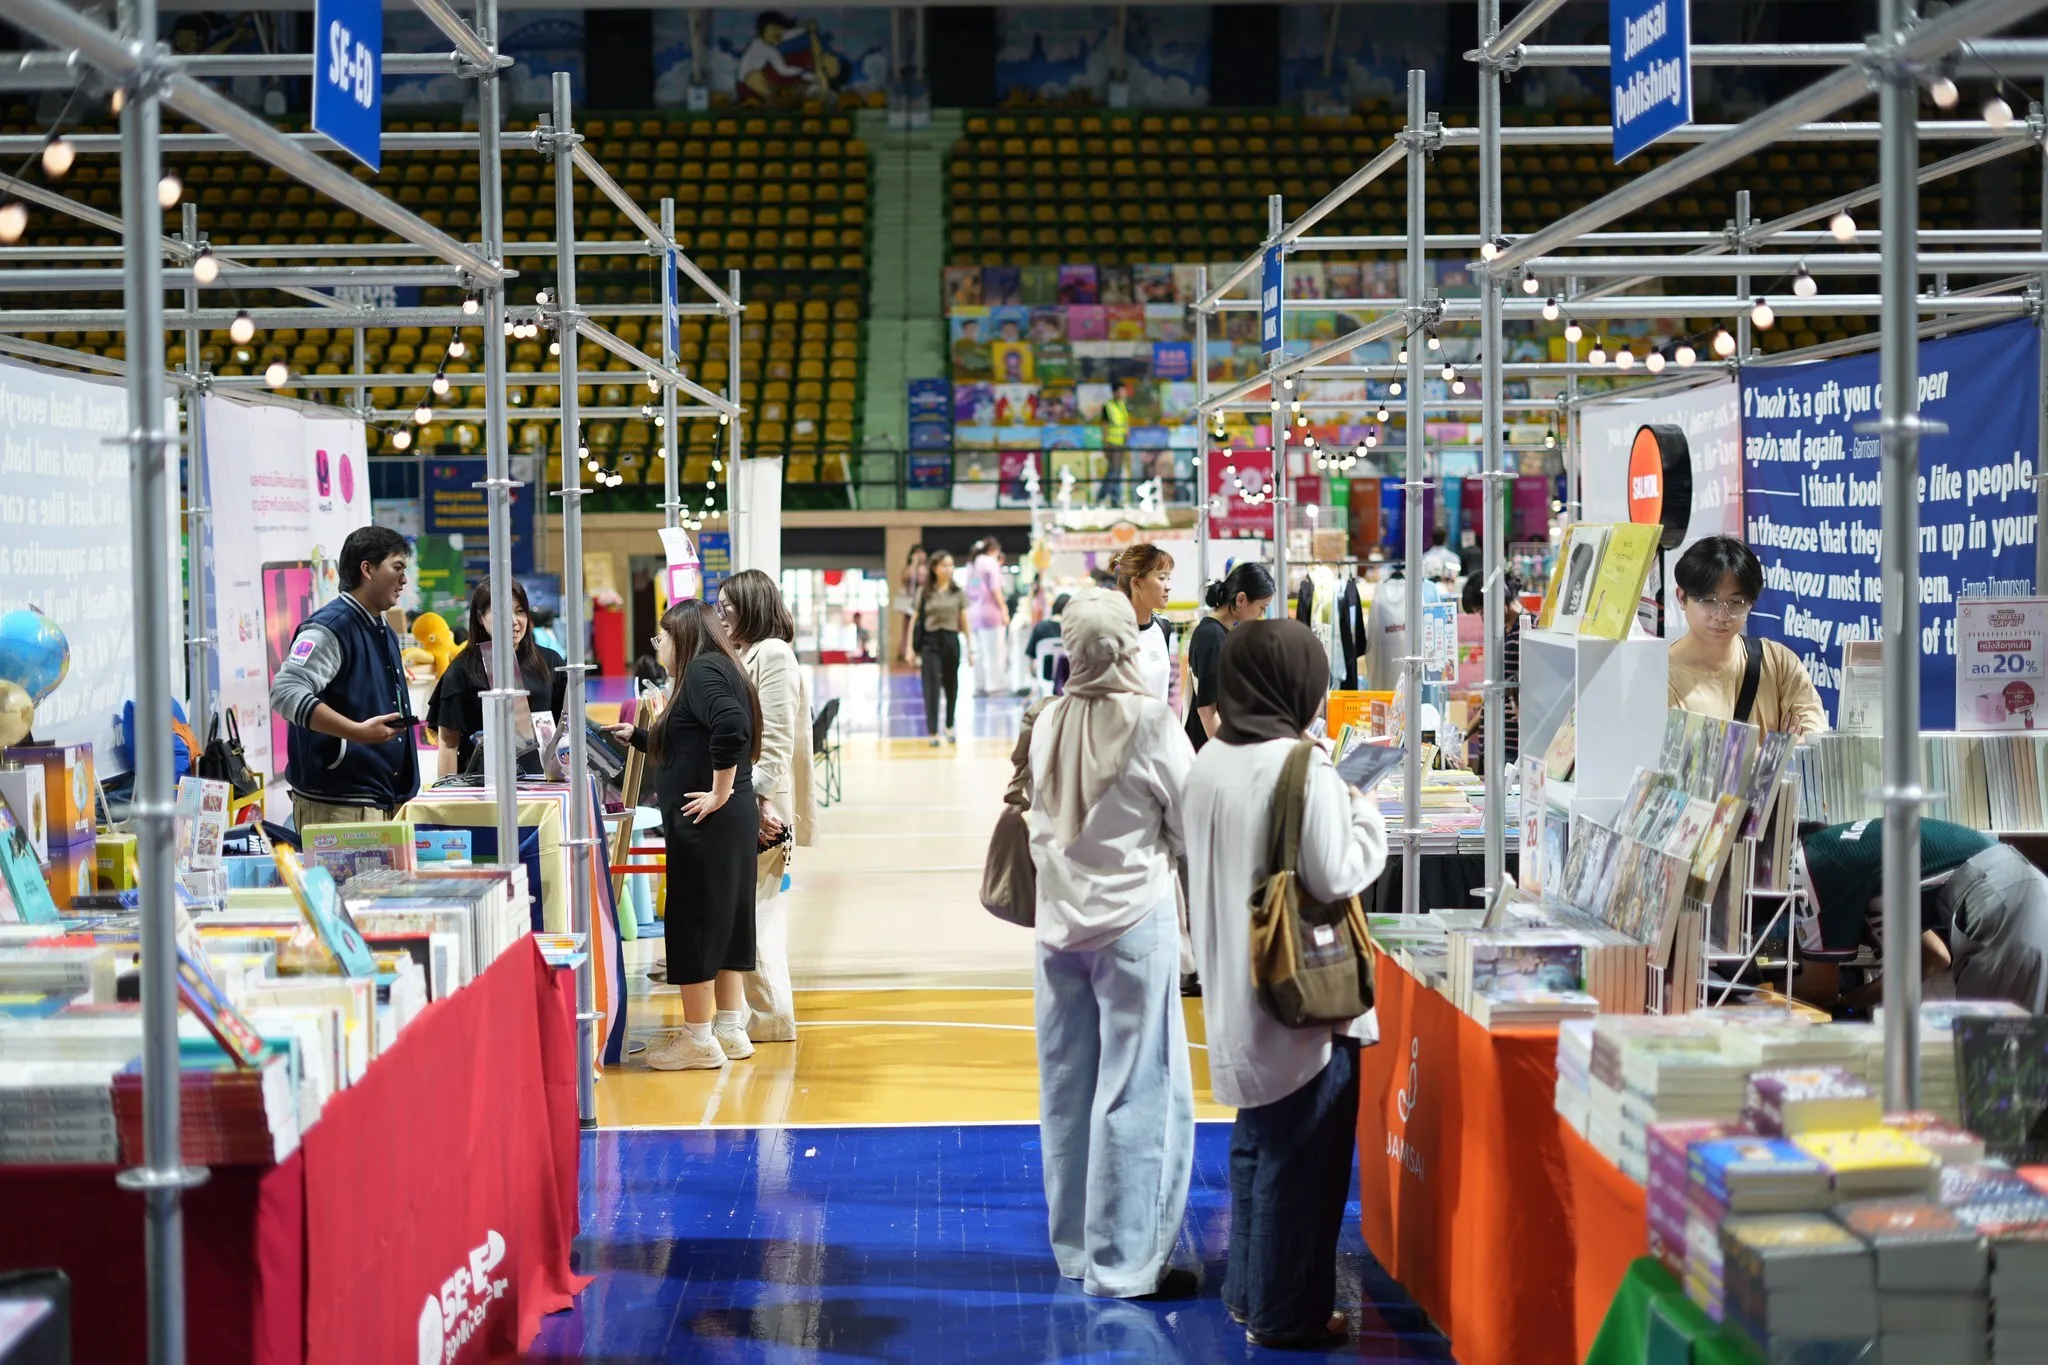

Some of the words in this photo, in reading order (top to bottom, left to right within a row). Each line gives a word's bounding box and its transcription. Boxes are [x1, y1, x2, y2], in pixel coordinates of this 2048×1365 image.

[1624, 1, 1667, 62] Jamsai
[329, 20, 373, 109] SE-ED
[1616, 57, 1681, 129] Publishing
[1788, 387, 1801, 418] is
[1803, 392, 1812, 418] a
[1814, 380, 1841, 425] gift
[1843, 385, 1871, 422] you
[1917, 370, 1949, 412] pen
[1779, 429, 1802, 462] and
[1803, 429, 1846, 470] again.
[1852, 436, 1880, 460] Garrison
[1801, 474, 1807, 507] I
[1808, 473, 1846, 508] think
[1930, 463, 1962, 502] like
[1967, 451, 2038, 506] people,
[1820, 520, 1848, 554] that
[1851, 520, 1883, 564] they
[1942, 523, 1965, 560] up
[1968, 514, 1987, 549] in
[1991, 514, 2039, 558] your
[1827, 569, 1861, 602] most
[1962, 577, 1987, 598] Emma
[1988, 576, 2031, 598] Thompson
[1922, 616, 1941, 655] of
[1972, 664, 1990, 674] ลด
[1385, 1131, 1425, 1184] JAMSAI
